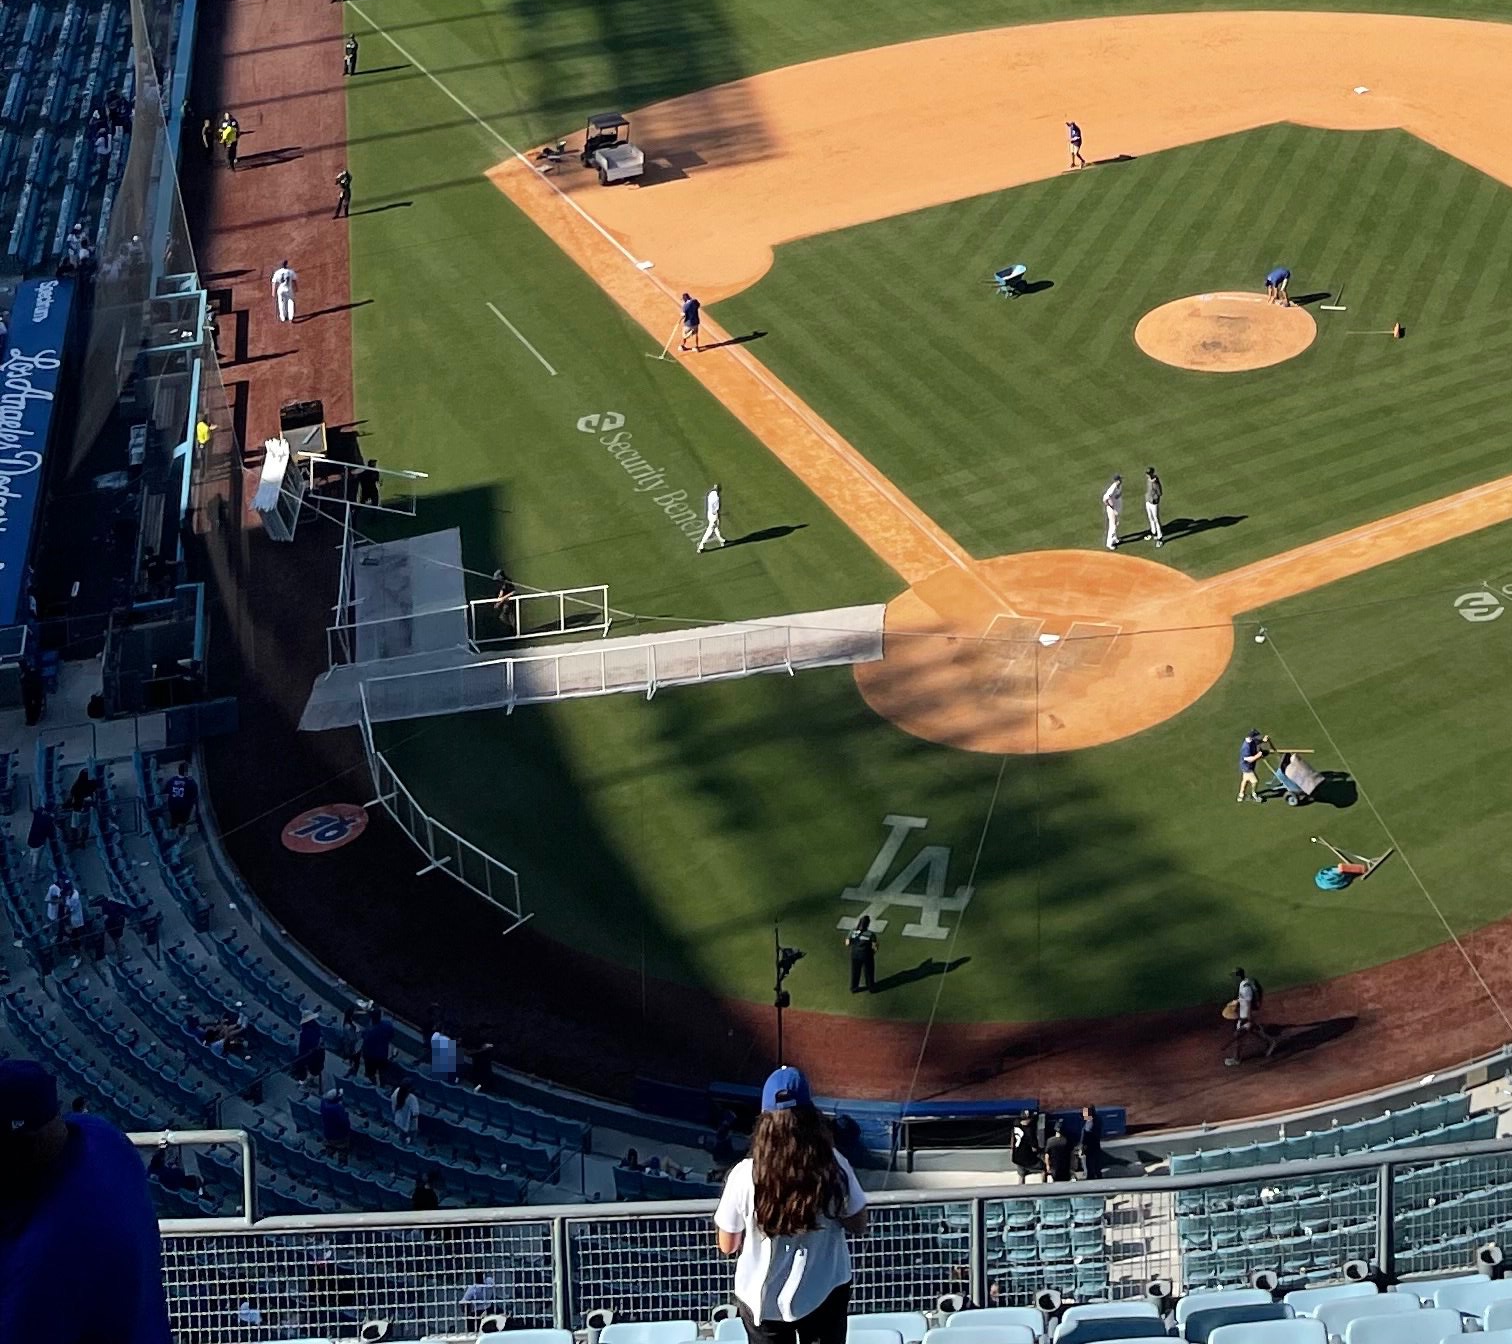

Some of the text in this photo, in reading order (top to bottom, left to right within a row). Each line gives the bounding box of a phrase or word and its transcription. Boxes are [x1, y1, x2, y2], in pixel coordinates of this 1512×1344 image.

[31, 280, 59, 324] Spectrum
[0, 348, 60, 533] Los Angeles Dodge
[600, 431, 707, 542] Security Bene
[290, 812, 363, 846] 76
[836, 814, 976, 940] LA
